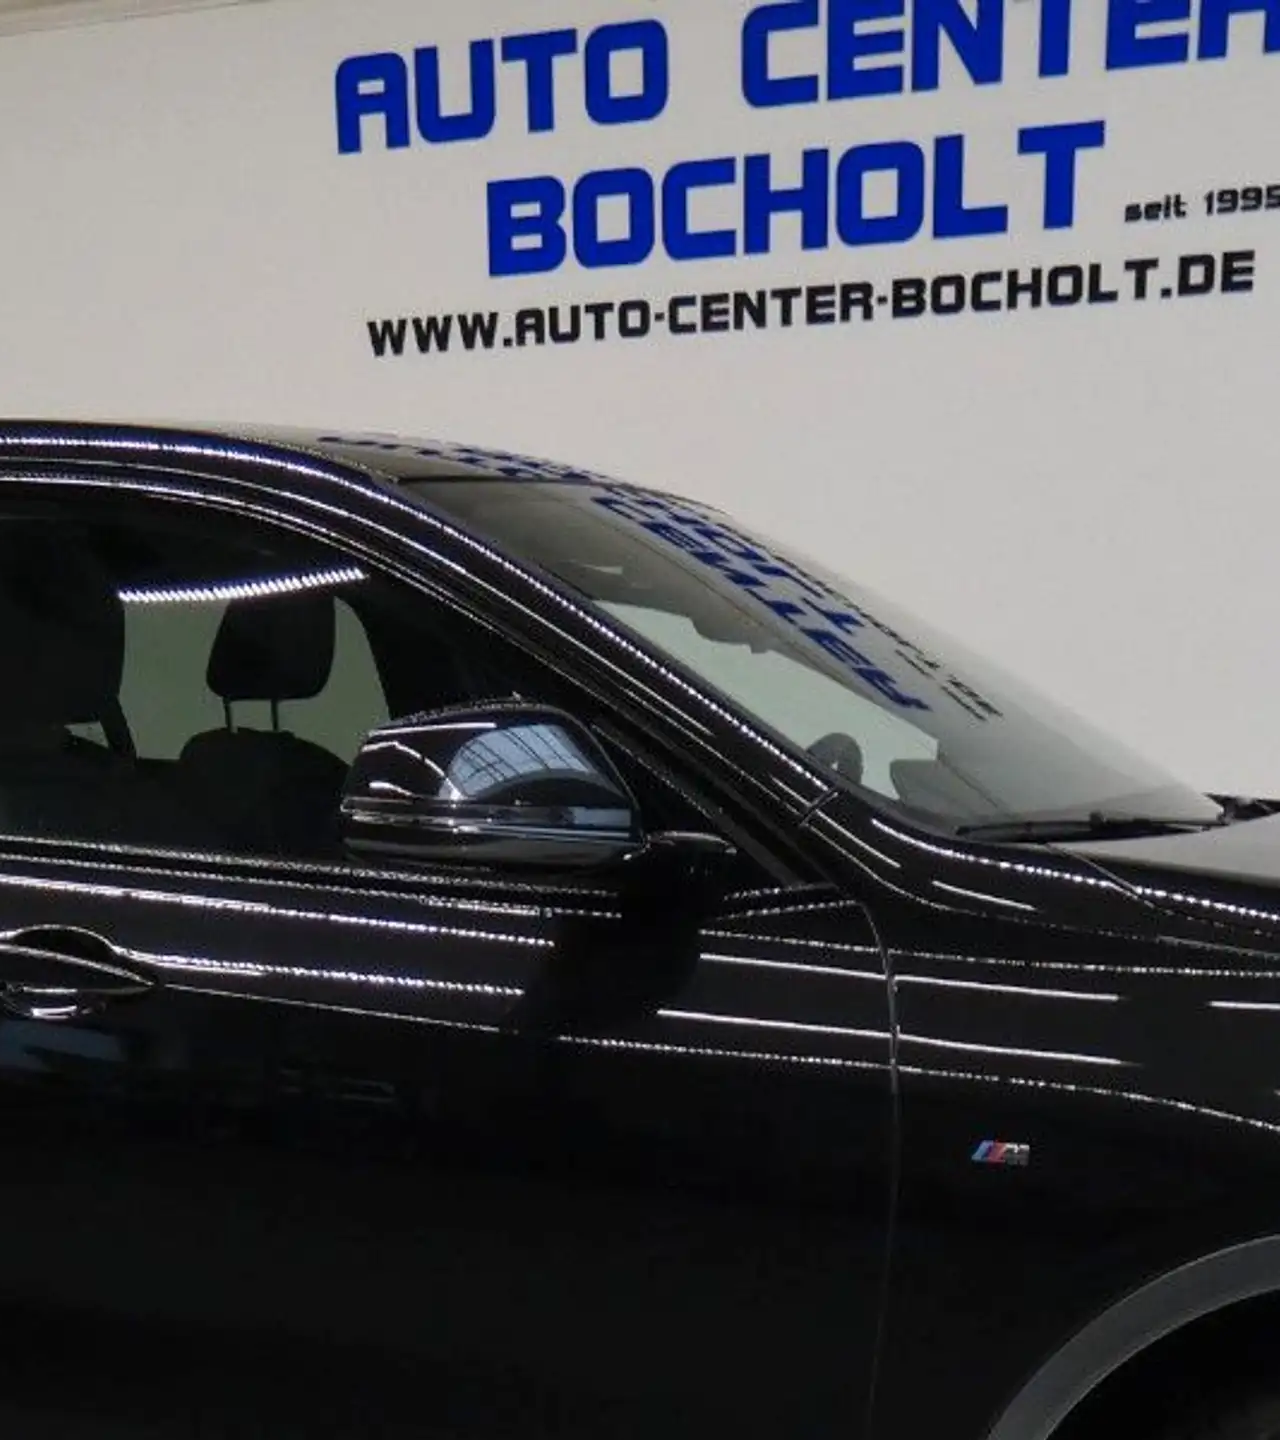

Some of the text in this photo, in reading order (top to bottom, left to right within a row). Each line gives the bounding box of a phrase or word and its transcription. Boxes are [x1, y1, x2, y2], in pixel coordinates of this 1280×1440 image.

[335, 20, 670, 155] AUTO
[486, 120, 1105, 278] BOCHOLT
[1123, 193, 1188, 224] seit
[366, 249, 1256, 357] WWW.AUTO-CENTER-BOCHOLT.DE
